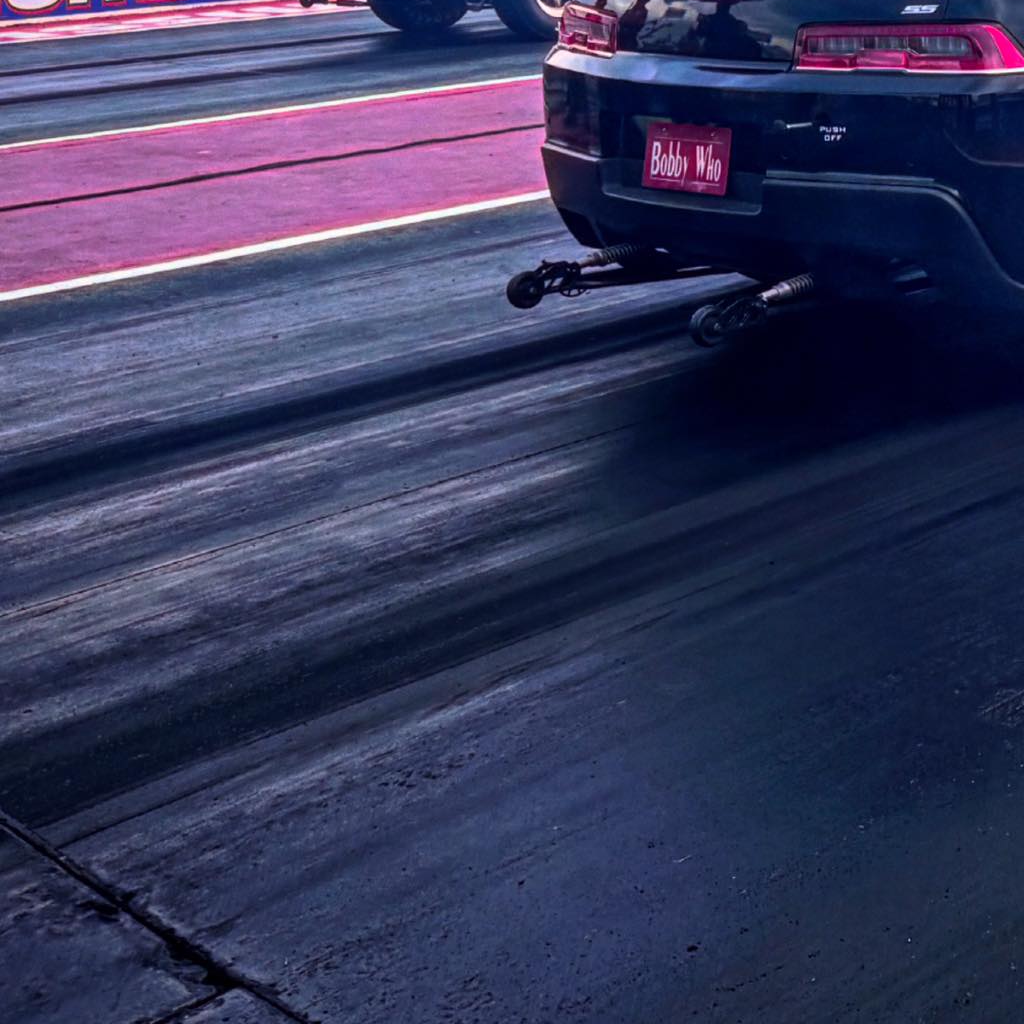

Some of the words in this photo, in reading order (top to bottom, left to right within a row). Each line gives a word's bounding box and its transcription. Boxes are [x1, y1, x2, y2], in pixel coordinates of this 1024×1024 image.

[824, 134, 842, 142] OFF
[650, 141, 689, 187] Bobby
[695, 144, 722, 182] Who
